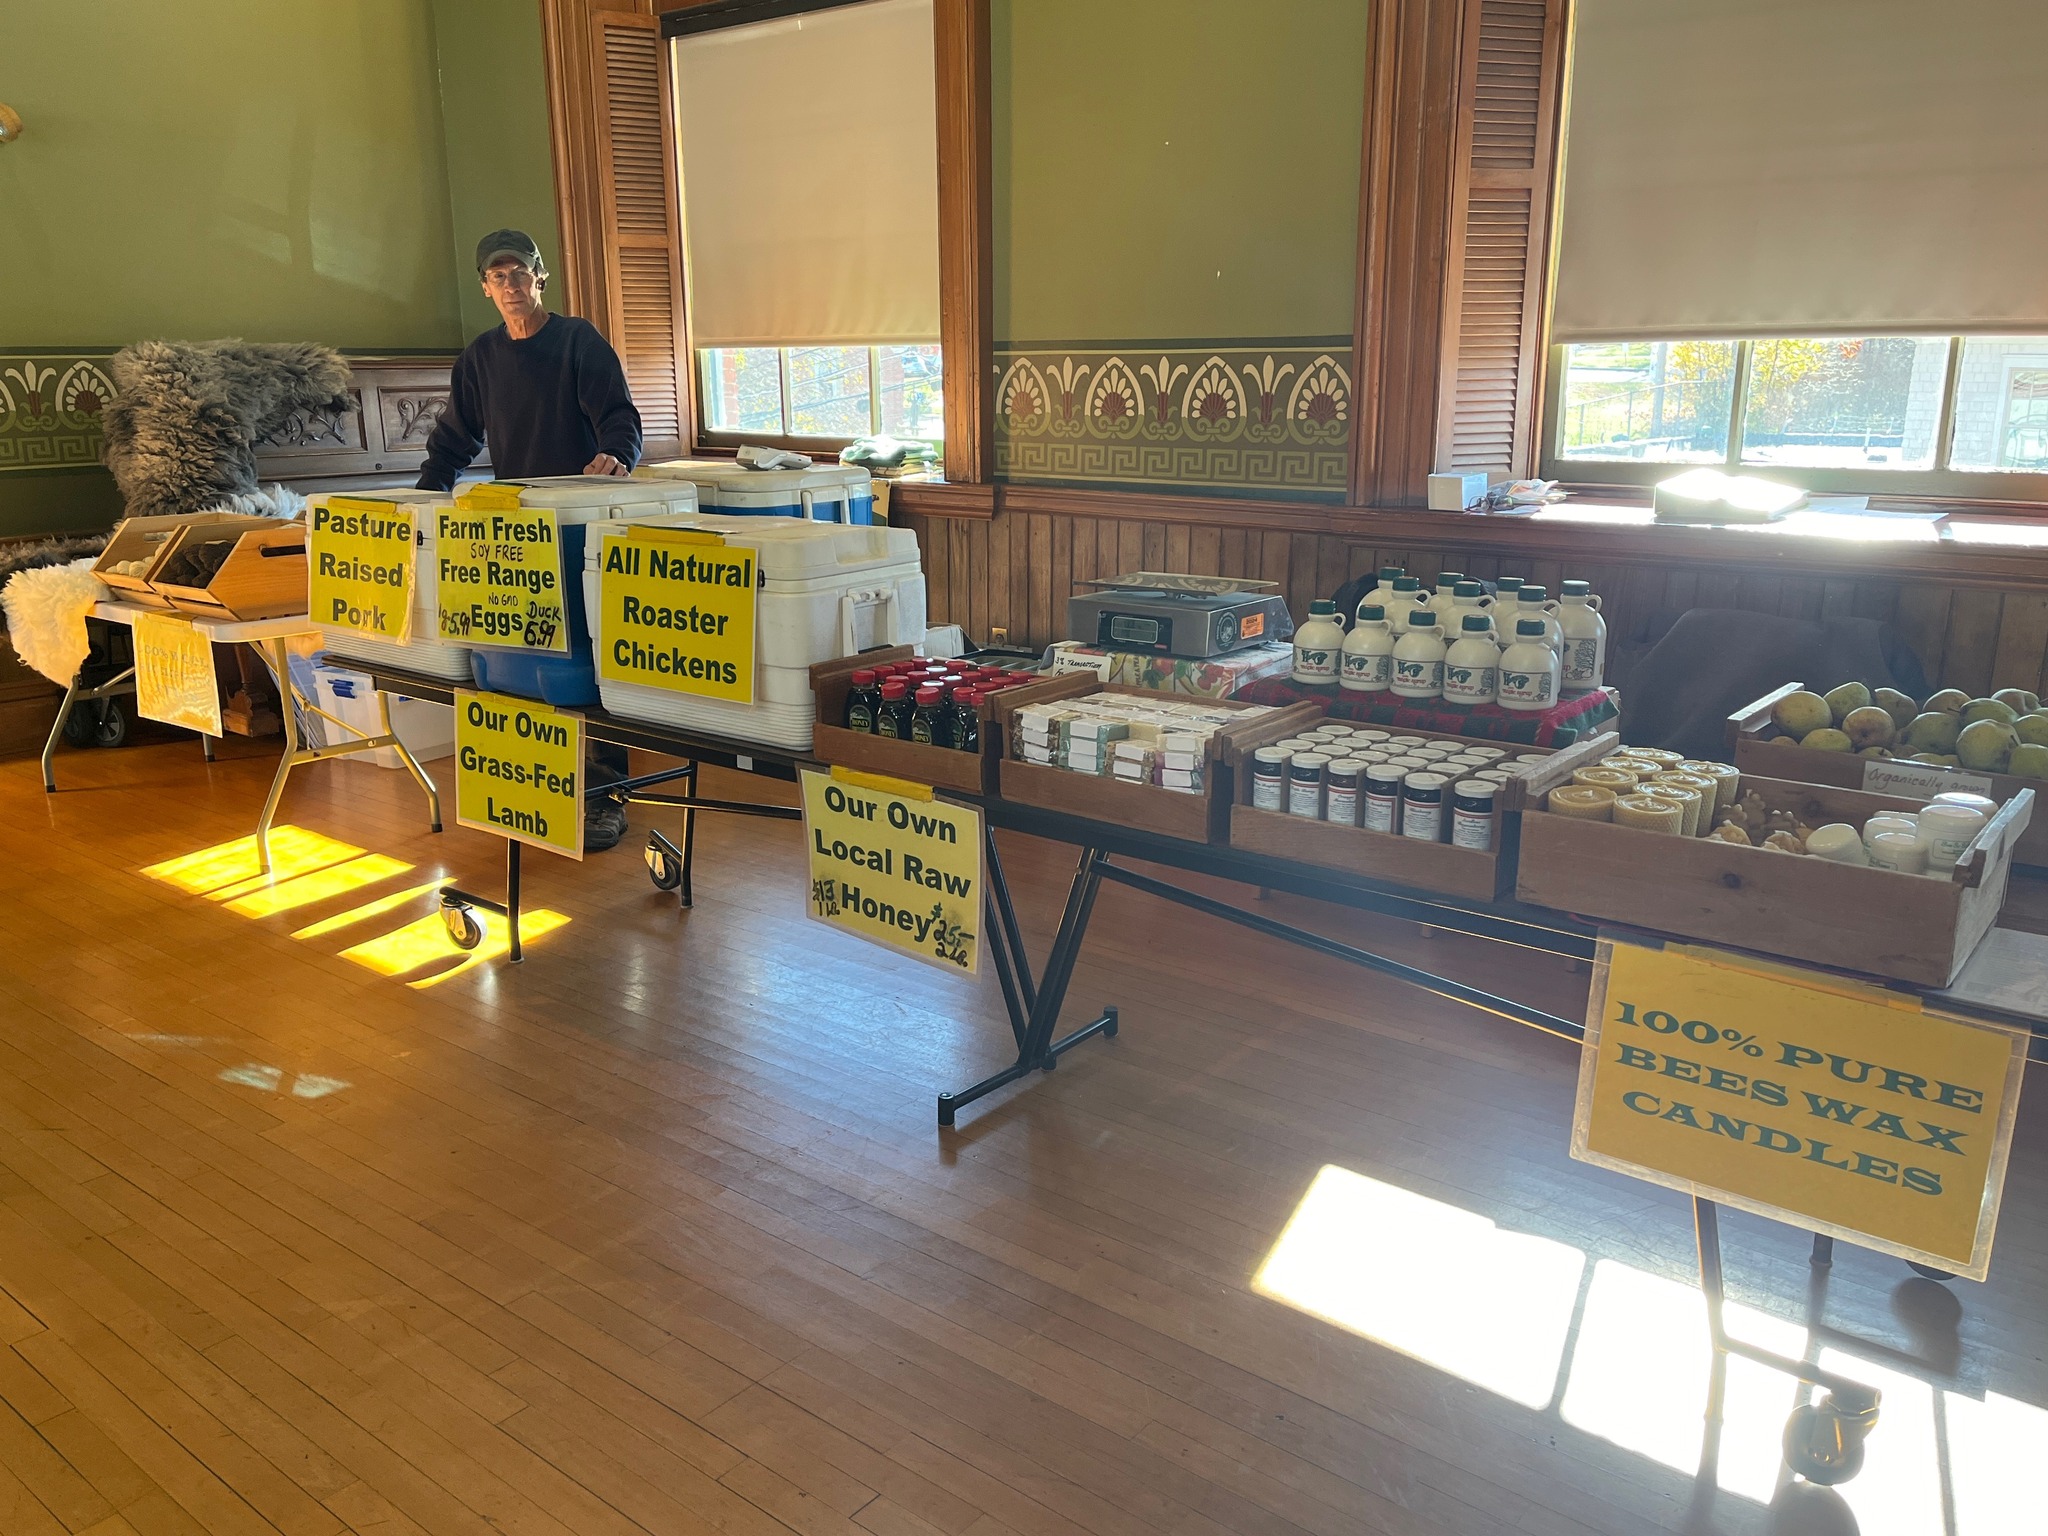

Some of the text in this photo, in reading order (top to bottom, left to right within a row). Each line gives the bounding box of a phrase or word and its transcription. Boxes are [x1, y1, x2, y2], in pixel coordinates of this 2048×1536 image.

[314, 507, 411, 541] Pasture
[439, 515, 552, 543] Farm Fresh
[319, 552, 404, 587] Raised
[470, 542, 523, 562] SOY FREE
[605, 545, 751, 588] All Natural
[440, 558, 555, 594] Free Range
[332, 598, 387, 631] Pork
[471, 604, 523, 636] Eggs
[623, 595, 729, 636] Roaster
[613, 638, 737, 684] Chickens
[467, 701, 568, 748] Our Own
[460, 745, 575, 798] Grass-Fed
[1869, 767, 1943, 792] Organically
[487, 796, 548, 838] Lamb
[824, 785, 957, 844] Our Own
[814, 828, 971, 898] Local Raw
[842, 882, 932, 943] Honey
[1615, 999, 1985, 1114] 100% PURE
[1615, 1042, 1969, 1157] BEES WAX
[1622, 1090, 1943, 1196] CANDLES
